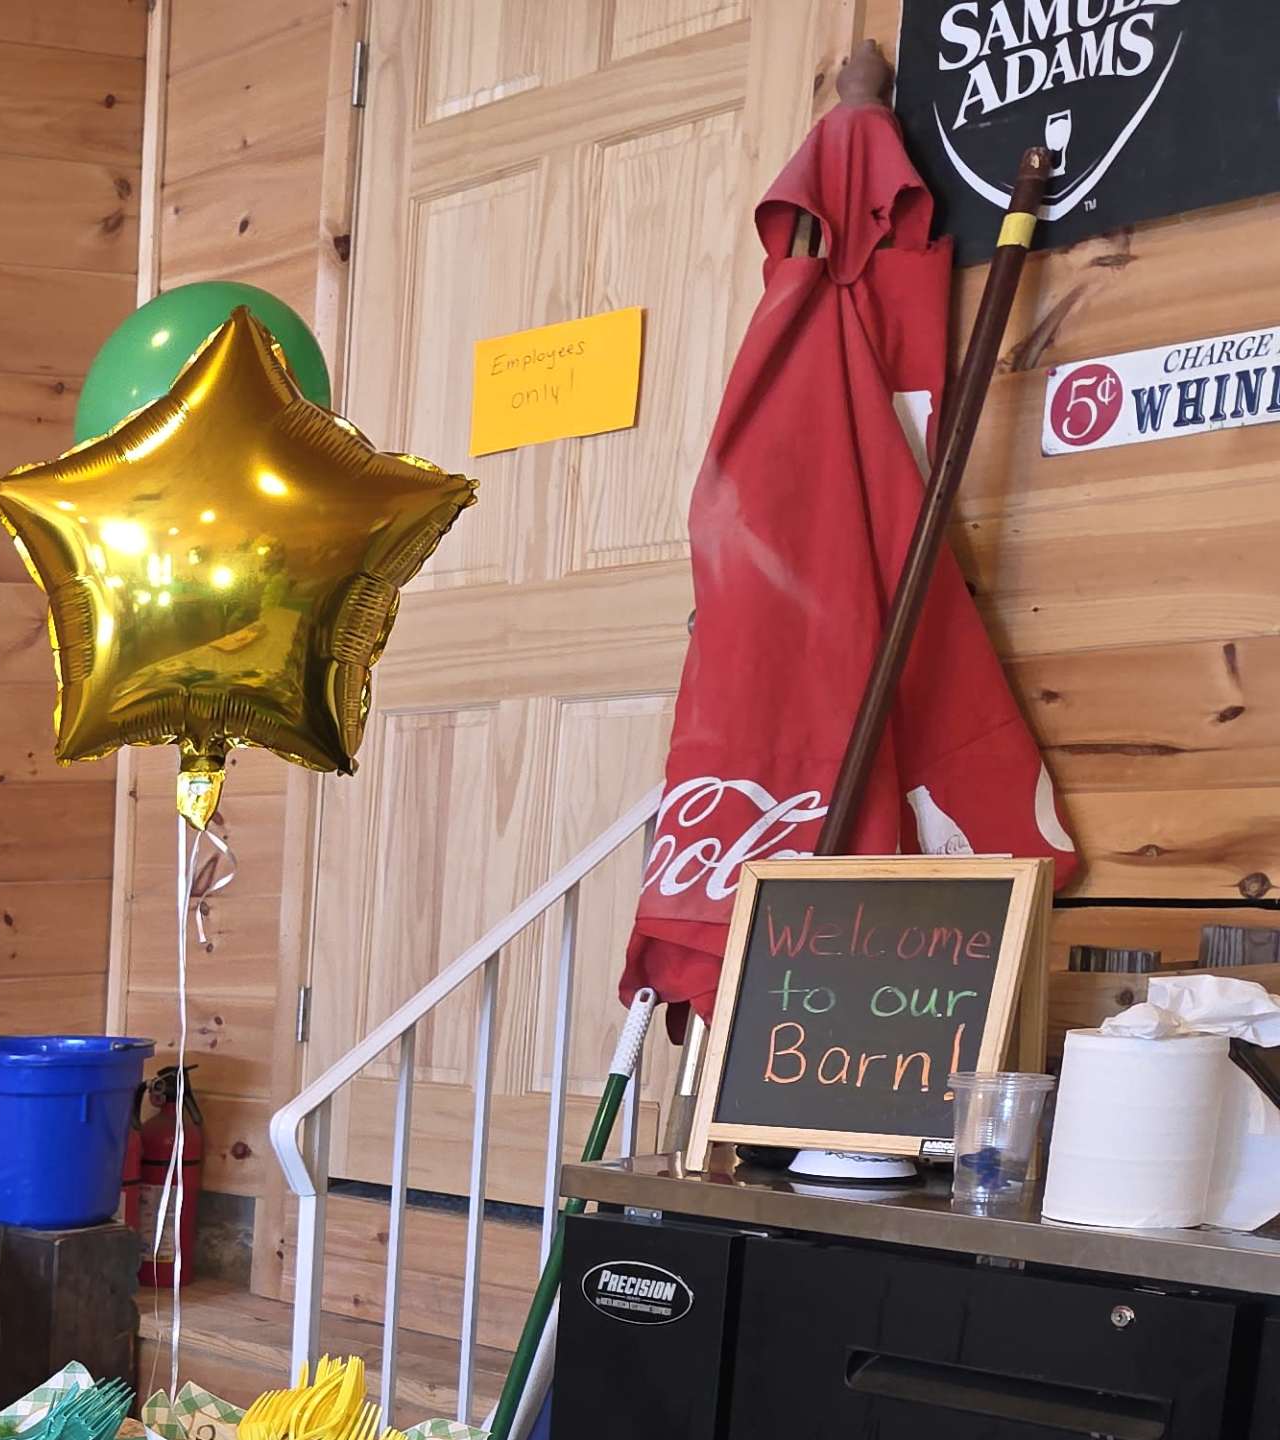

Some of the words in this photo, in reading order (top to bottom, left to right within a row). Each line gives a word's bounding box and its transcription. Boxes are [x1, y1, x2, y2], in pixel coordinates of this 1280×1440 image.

[939, 0, 1181, 71] SAMU
[952, 12, 1155, 130] ADAMS
[491, 341, 586, 376] Employees
[1163, 333, 1273, 373] CHARGE
[767, 903, 991, 965] Welcome
[768, 970, 837, 1013] to
[871, 986, 978, 1017] our
[763, 1022, 966, 1101] Barn!
[597, 1269, 677, 1302] PRECISION
